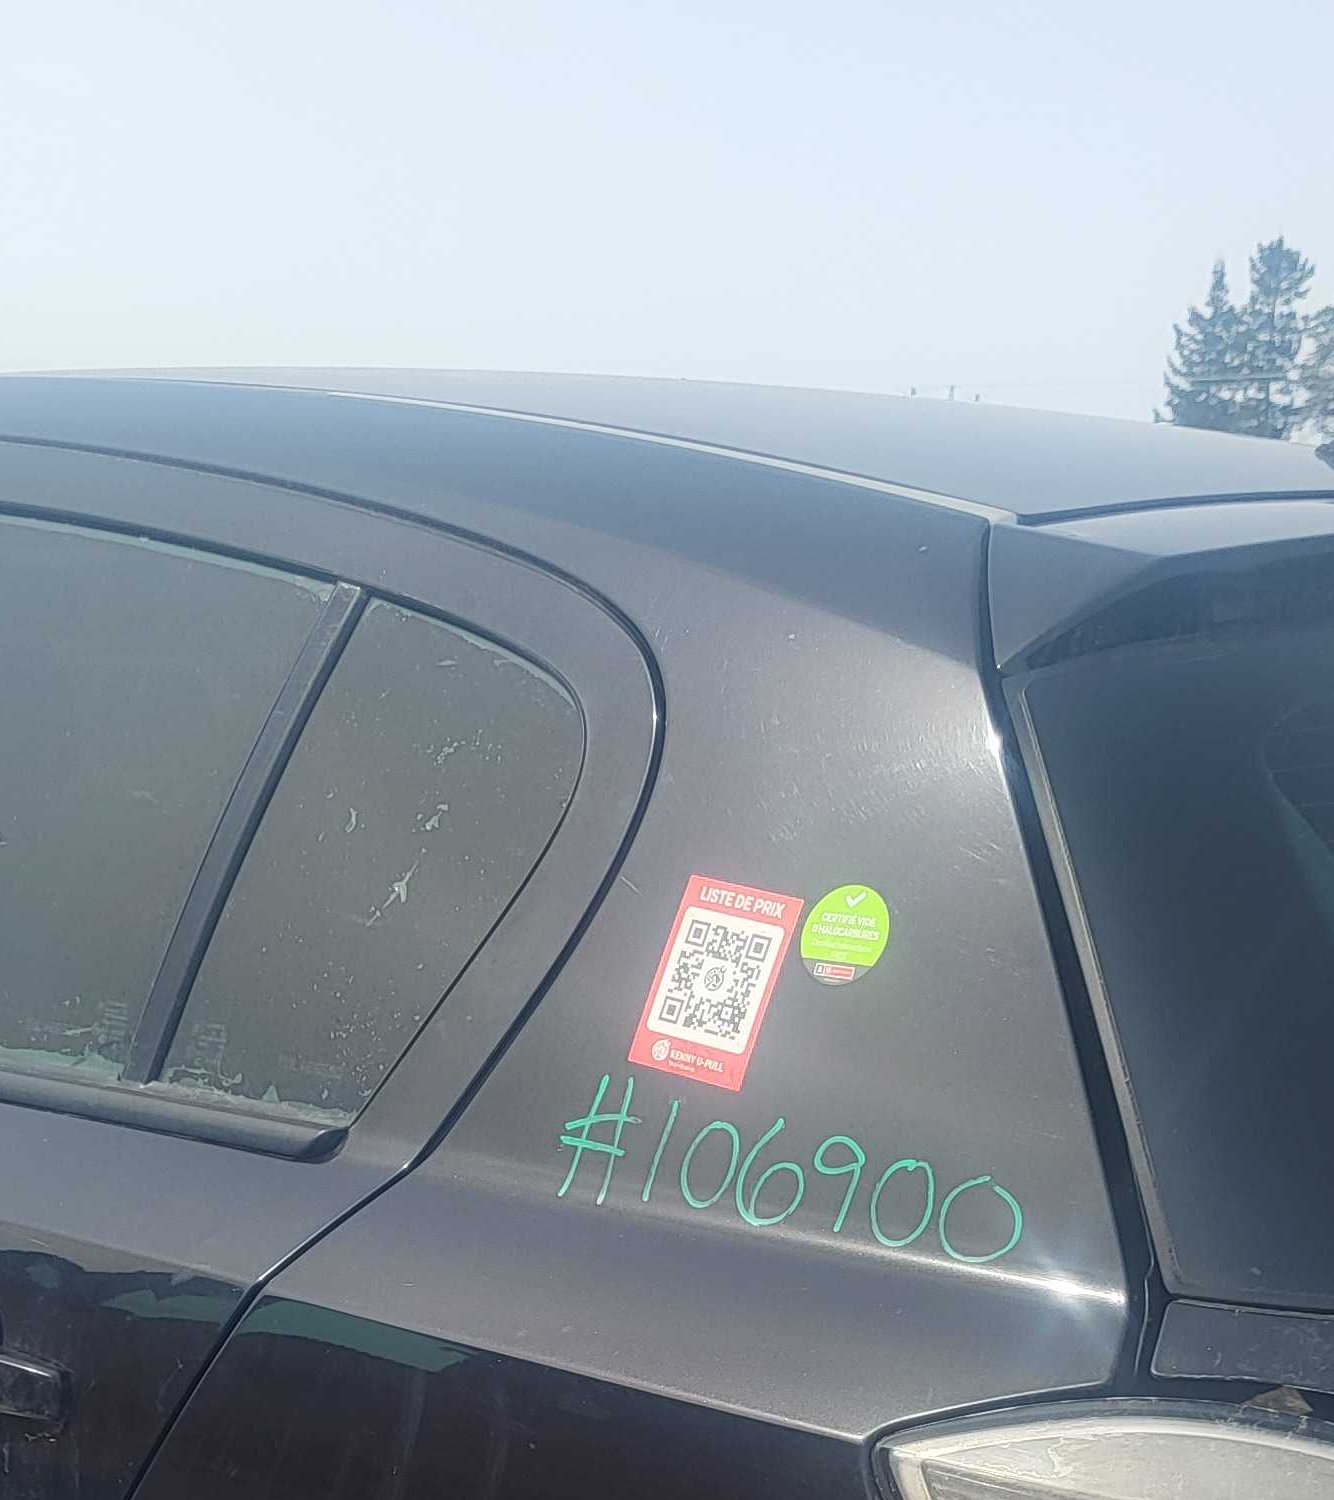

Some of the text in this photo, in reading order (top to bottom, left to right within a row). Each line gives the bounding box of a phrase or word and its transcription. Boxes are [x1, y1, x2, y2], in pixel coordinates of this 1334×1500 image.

[700, 886, 786, 919] LISTE DE PRIX
[557, 1073, 1024, 1264] #106900
